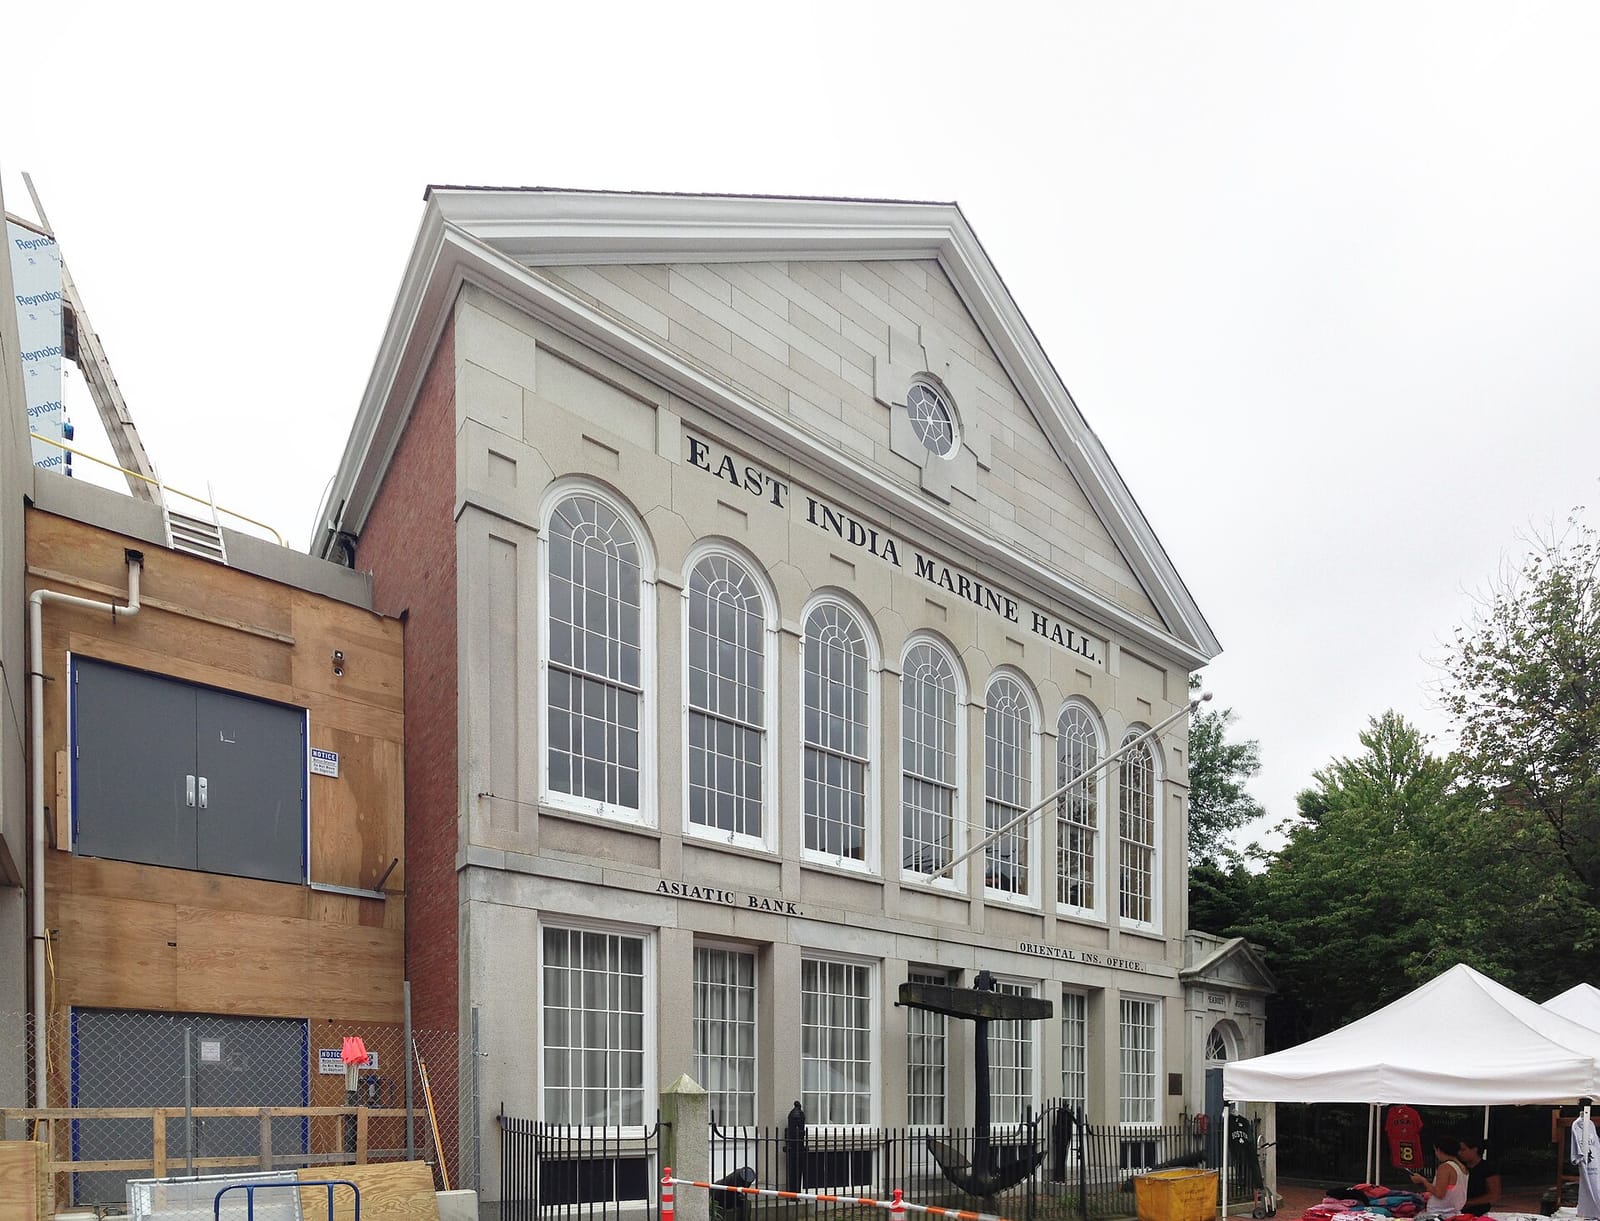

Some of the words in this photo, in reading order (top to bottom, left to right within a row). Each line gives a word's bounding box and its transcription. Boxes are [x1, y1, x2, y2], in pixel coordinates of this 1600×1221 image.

[16, 290, 61, 306] Reynobo
[21, 345, 62, 361] Reynobo
[27, 400, 62, 417] eynobo
[686, 435, 789, 508] EAST
[806, 496, 902, 567] INDIA
[914, 552, 1019, 624] MARINE
[1031, 610, 1102, 665] HALL.
[312, 751, 336, 761] NOTICE
[655, 880, 735, 904] ASIATIC
[748, 895, 804, 915] BANK.
[1019, 942, 1075, 960] ORIENTAL
[1081, 952, 1102, 964] INS.
[1106, 957, 1144, 971] OFFICE.
